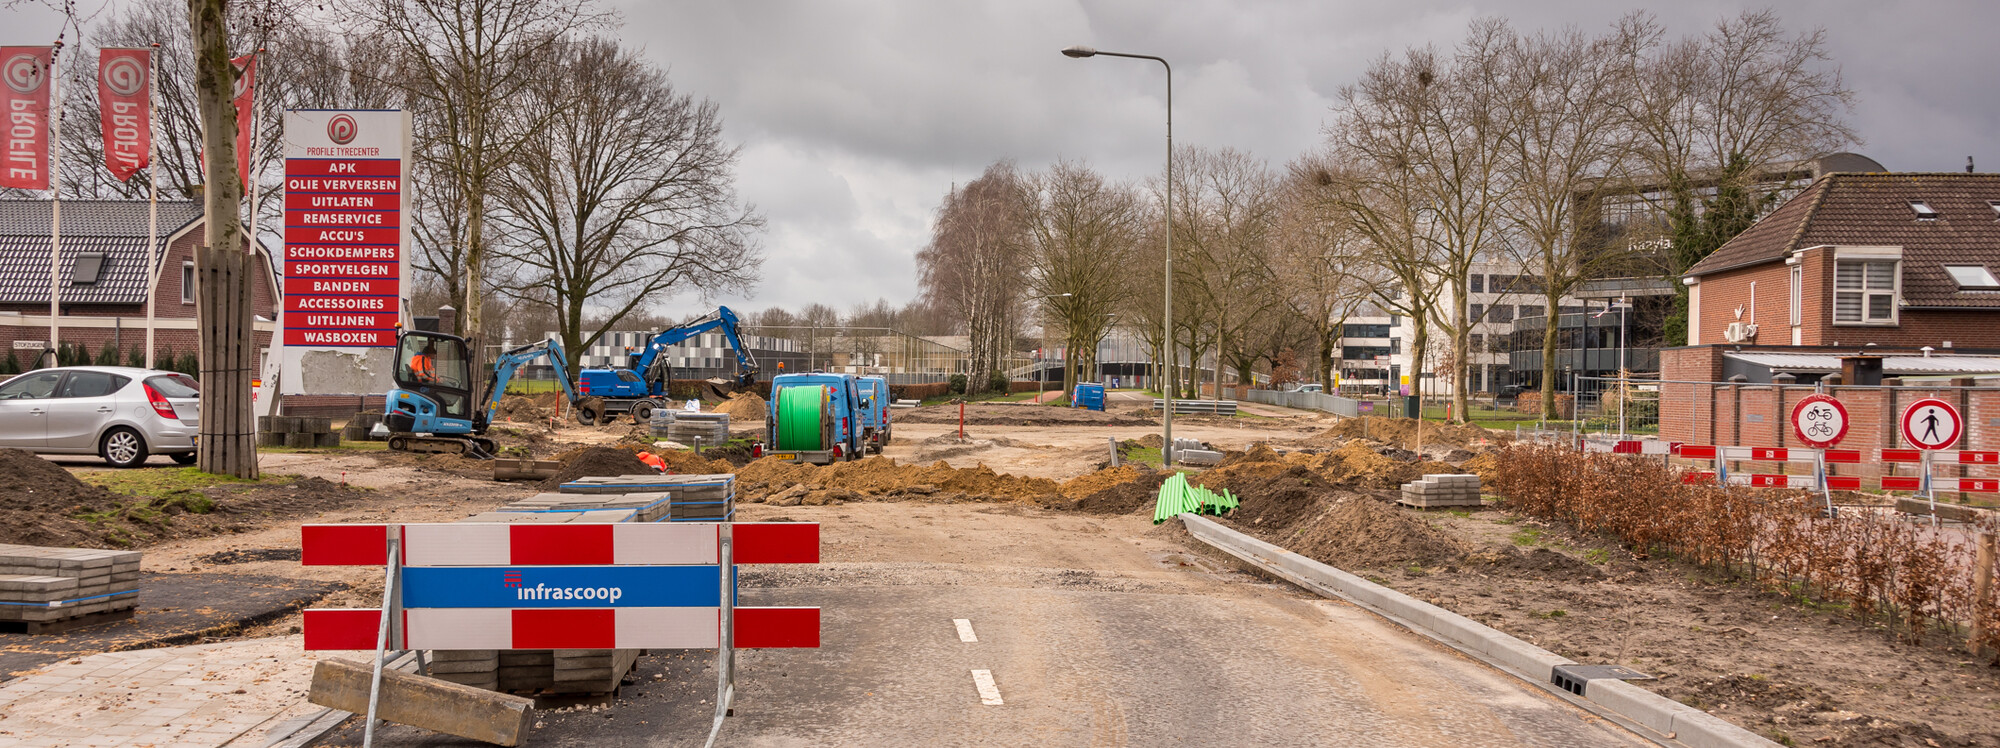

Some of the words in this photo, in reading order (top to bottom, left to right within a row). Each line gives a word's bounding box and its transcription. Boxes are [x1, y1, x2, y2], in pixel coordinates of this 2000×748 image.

[306, 147, 335, 156] PROFILE
[336, 147, 380, 157] TYRECENTER
[328, 163, 356, 173] APK
[289, 179, 319, 190] OLIE
[322, 180, 397, 191] VERVERSEN
[311, 197, 374, 207] UITLATEN
[303, 214, 382, 224] REMSERVICE
[319, 231, 364, 241] ACCU'S
[289, 247, 395, 258] SCHOKDEMPERS
[295, 264, 388, 276] SPORTVELGEN
[313, 281, 370, 292] BANDEN
[298, 298, 384, 310] ACCESSOIRES
[307, 315, 375, 326] UITLIJNEN
[304, 332, 378, 343] WASBOXEN
[517, 582, 622, 604] infrascoop
